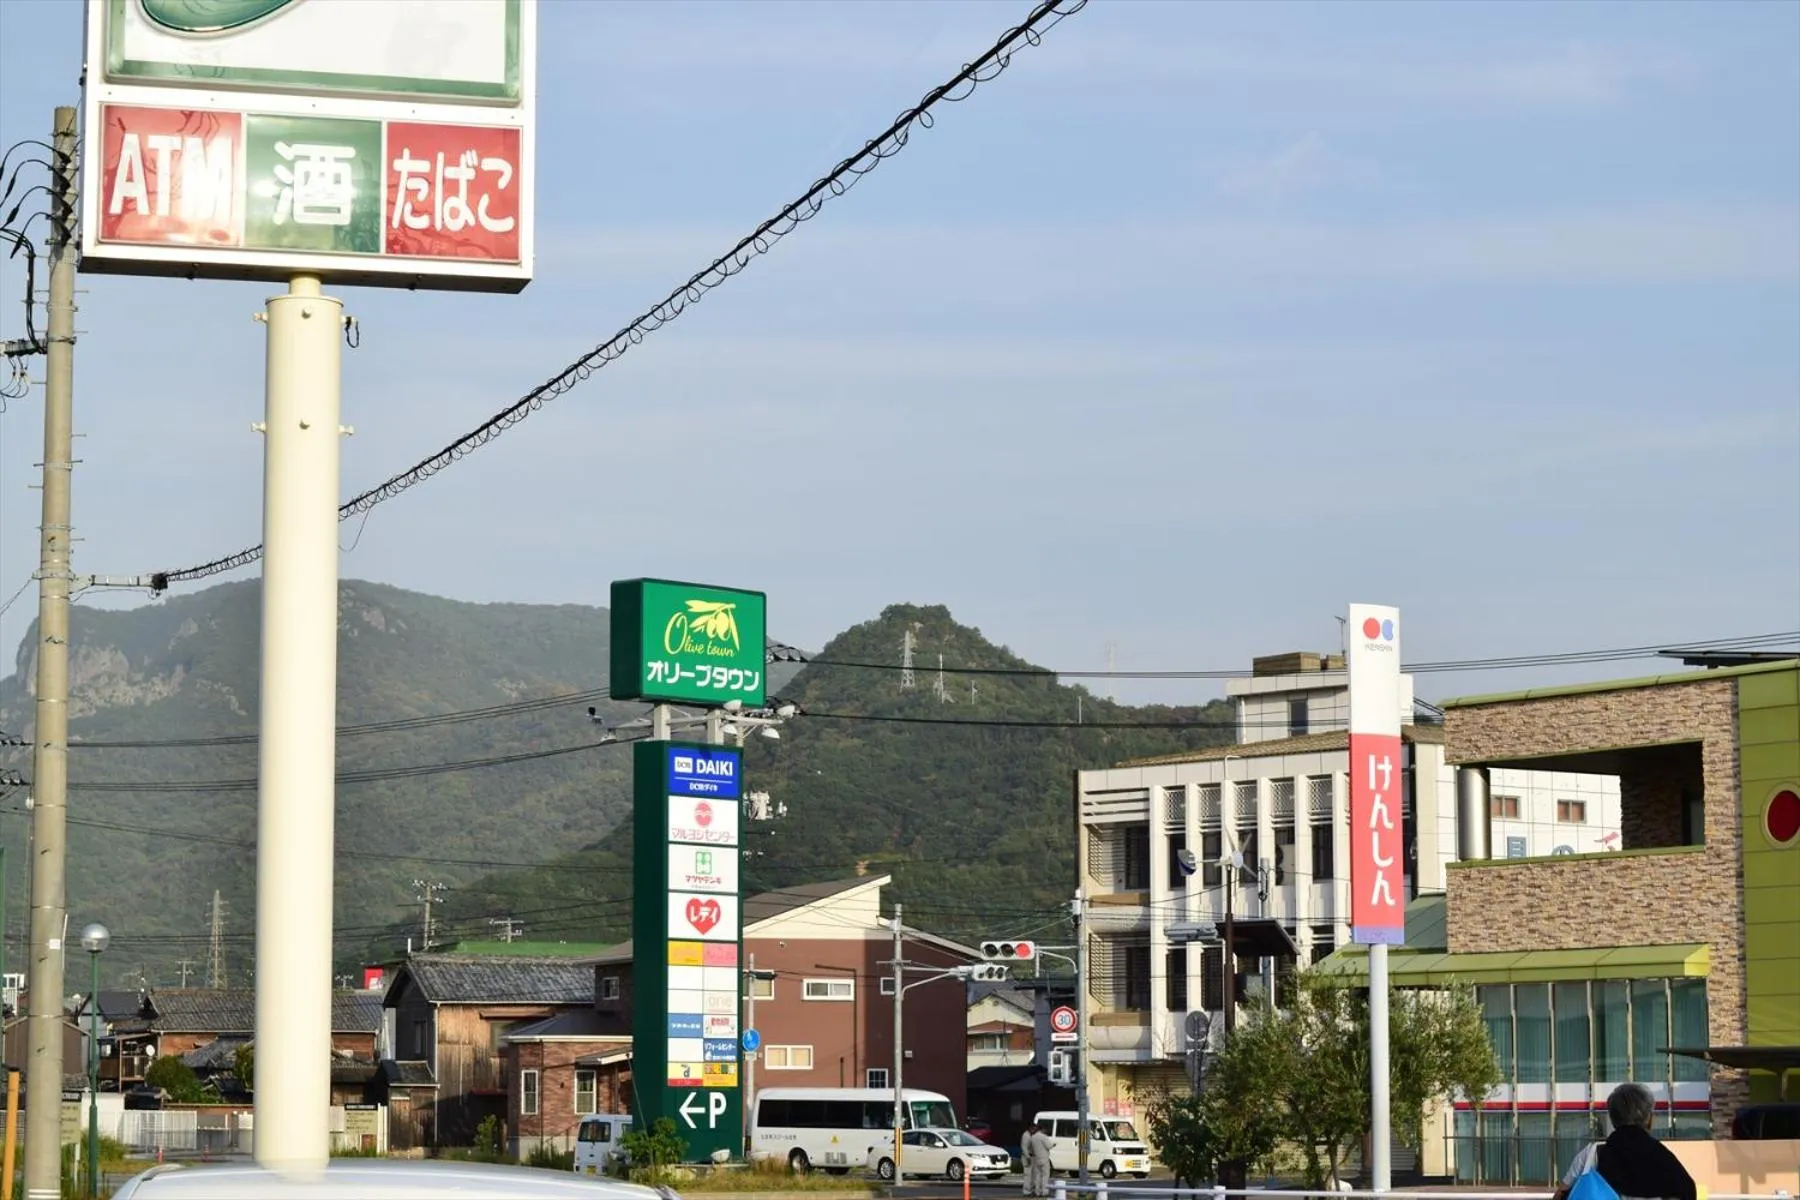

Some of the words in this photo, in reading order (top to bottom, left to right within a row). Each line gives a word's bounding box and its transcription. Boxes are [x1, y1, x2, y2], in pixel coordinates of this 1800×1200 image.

[109, 132, 234, 220] ATM
[271, 140, 357, 226] 酒
[392, 148, 515, 234] たばこ
[664, 611, 705, 655] Olive
[706, 641, 735, 657] town
[647, 660, 759, 691] オリーブタウン
[696, 759, 733, 776] DAIKI
[671, 827, 736, 843] マルヨシセンター
[1368, 753, 1396, 907] けんしん
[1057, 1014, 1071, 1026] 30
[709, 1091, 727, 1129] P
